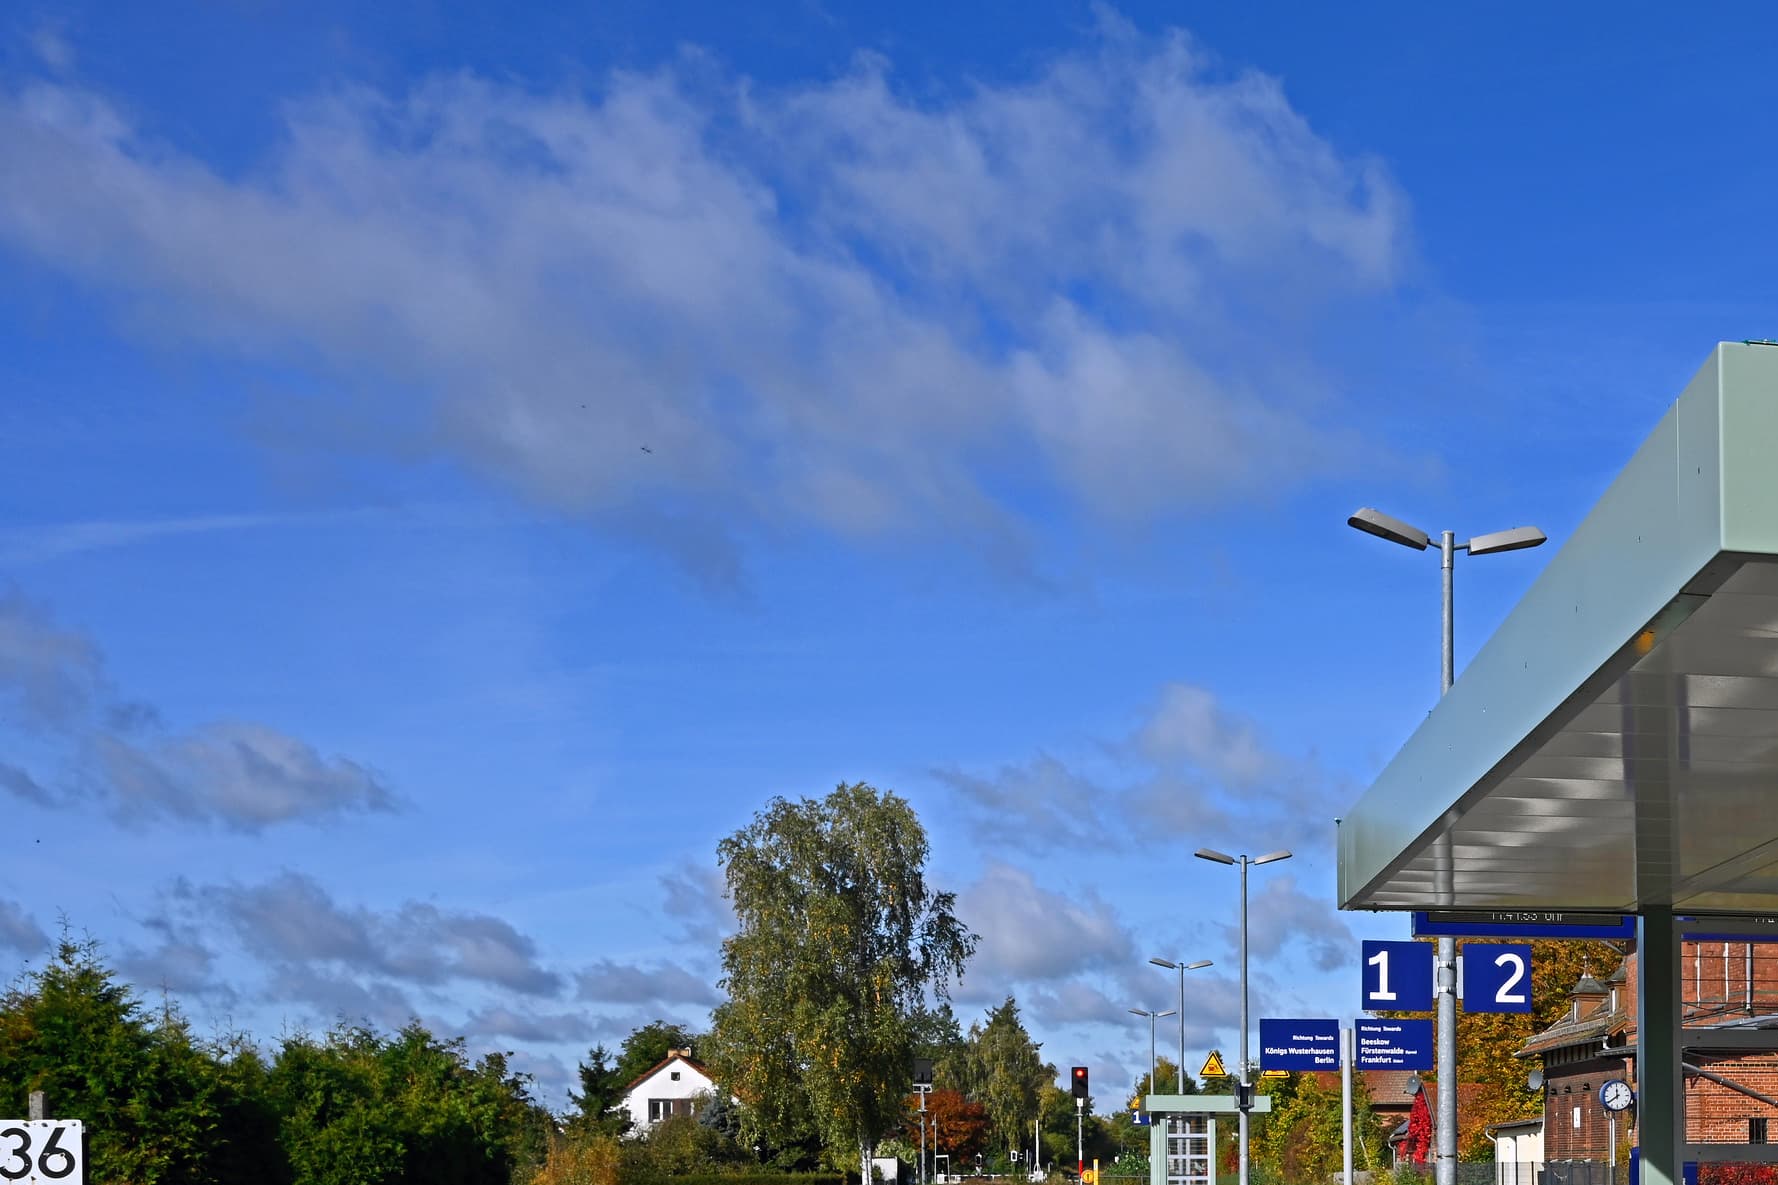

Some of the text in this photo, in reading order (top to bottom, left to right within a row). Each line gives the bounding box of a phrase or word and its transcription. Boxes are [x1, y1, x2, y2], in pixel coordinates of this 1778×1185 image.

[1368, 951, 1397, 1001] 1
[1494, 953, 1526, 1003] 2
[1265, 1047, 1288, 1055] Königs
[1314, 1056, 1335, 1064] Berlin
[1133, 1110, 1142, 1124] 1
[0, 1127, 76, 1179] 36
